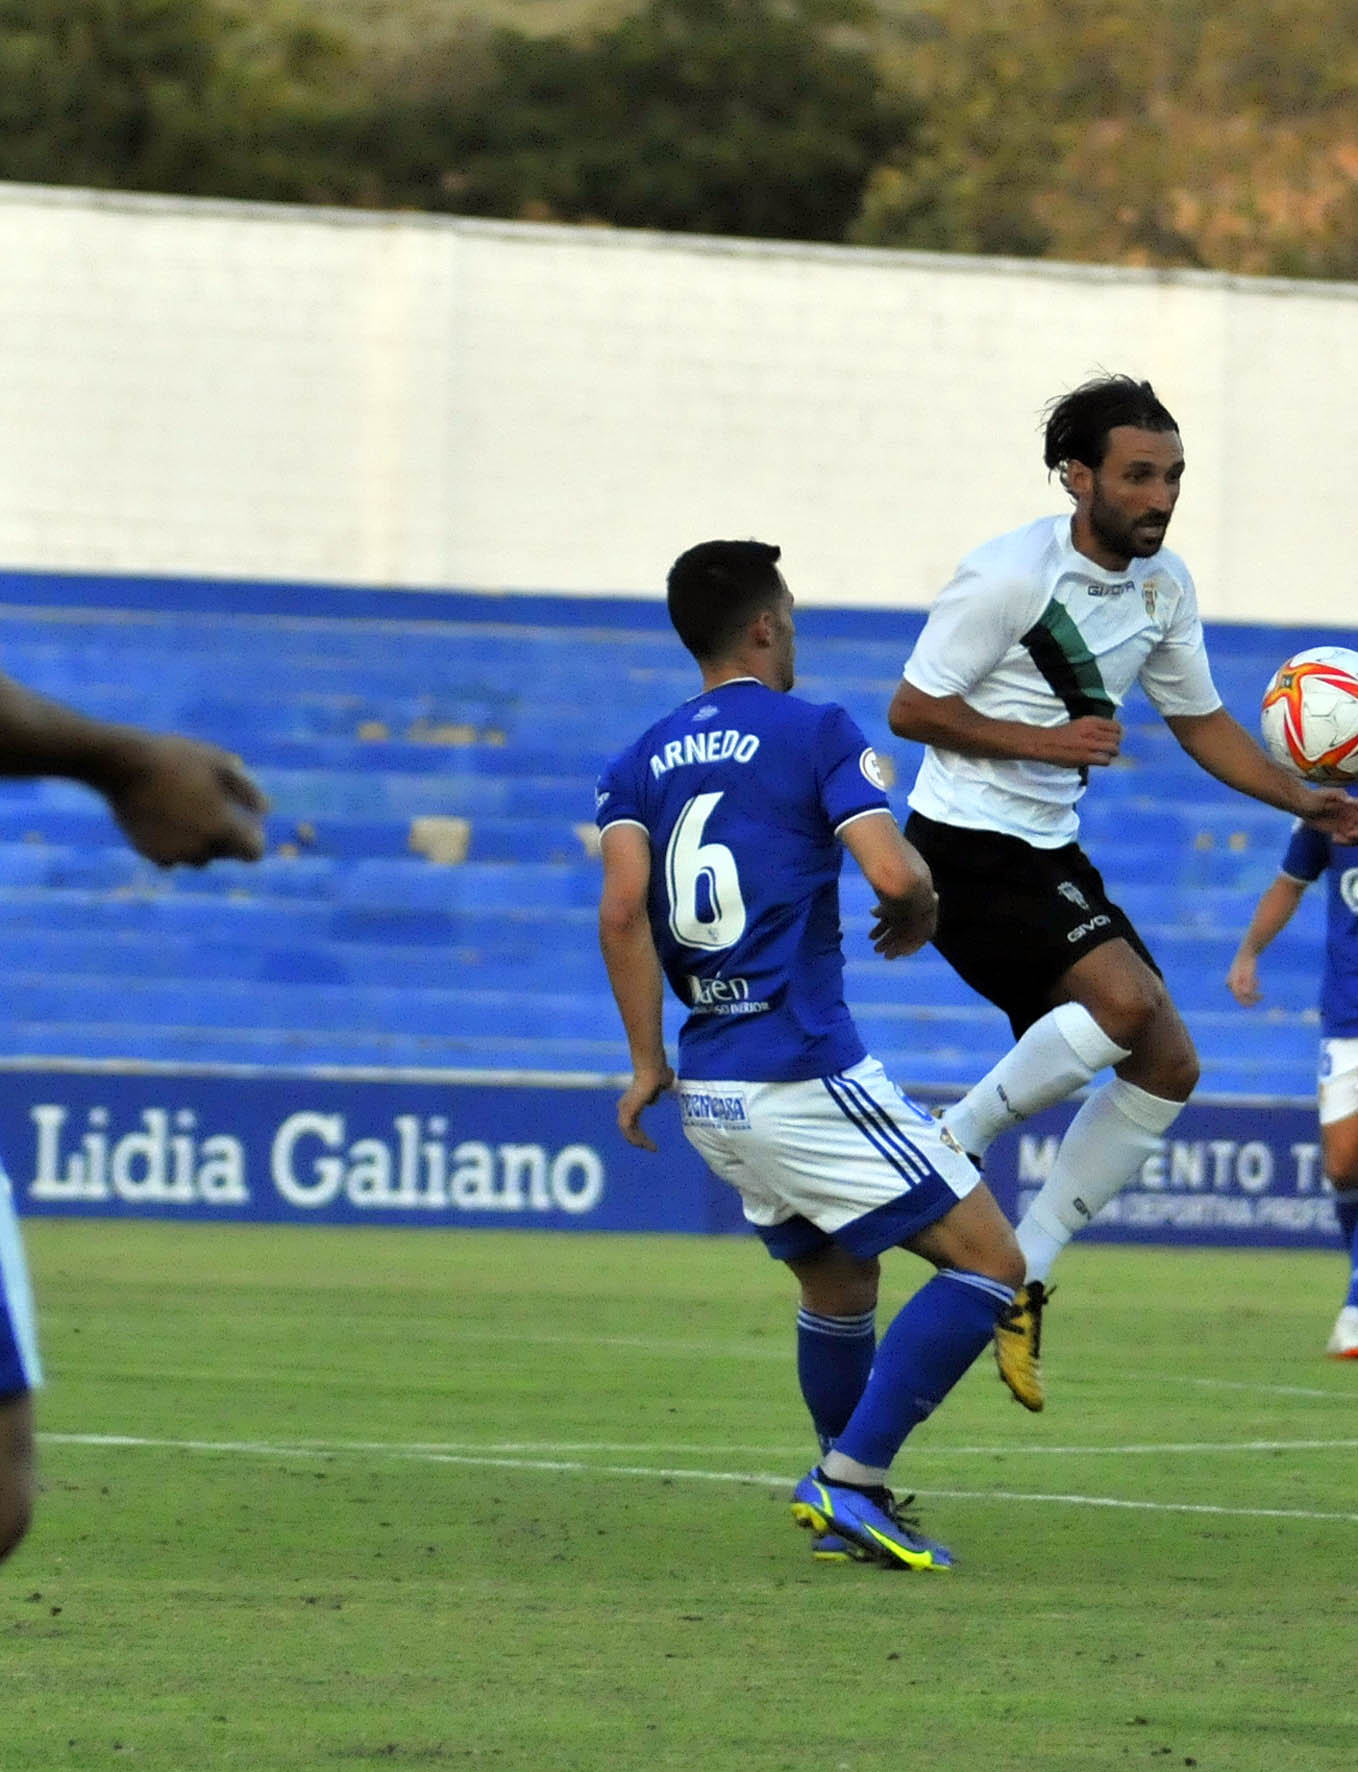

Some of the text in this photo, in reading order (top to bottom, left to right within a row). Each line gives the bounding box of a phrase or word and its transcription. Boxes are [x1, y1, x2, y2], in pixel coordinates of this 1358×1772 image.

[650, 729, 761, 780] ARNEDO
[665, 791, 746, 951] 6
[30, 1103, 604, 1214] Lidia Galiano
[1018, 1133, 1274, 1193] MENTO
